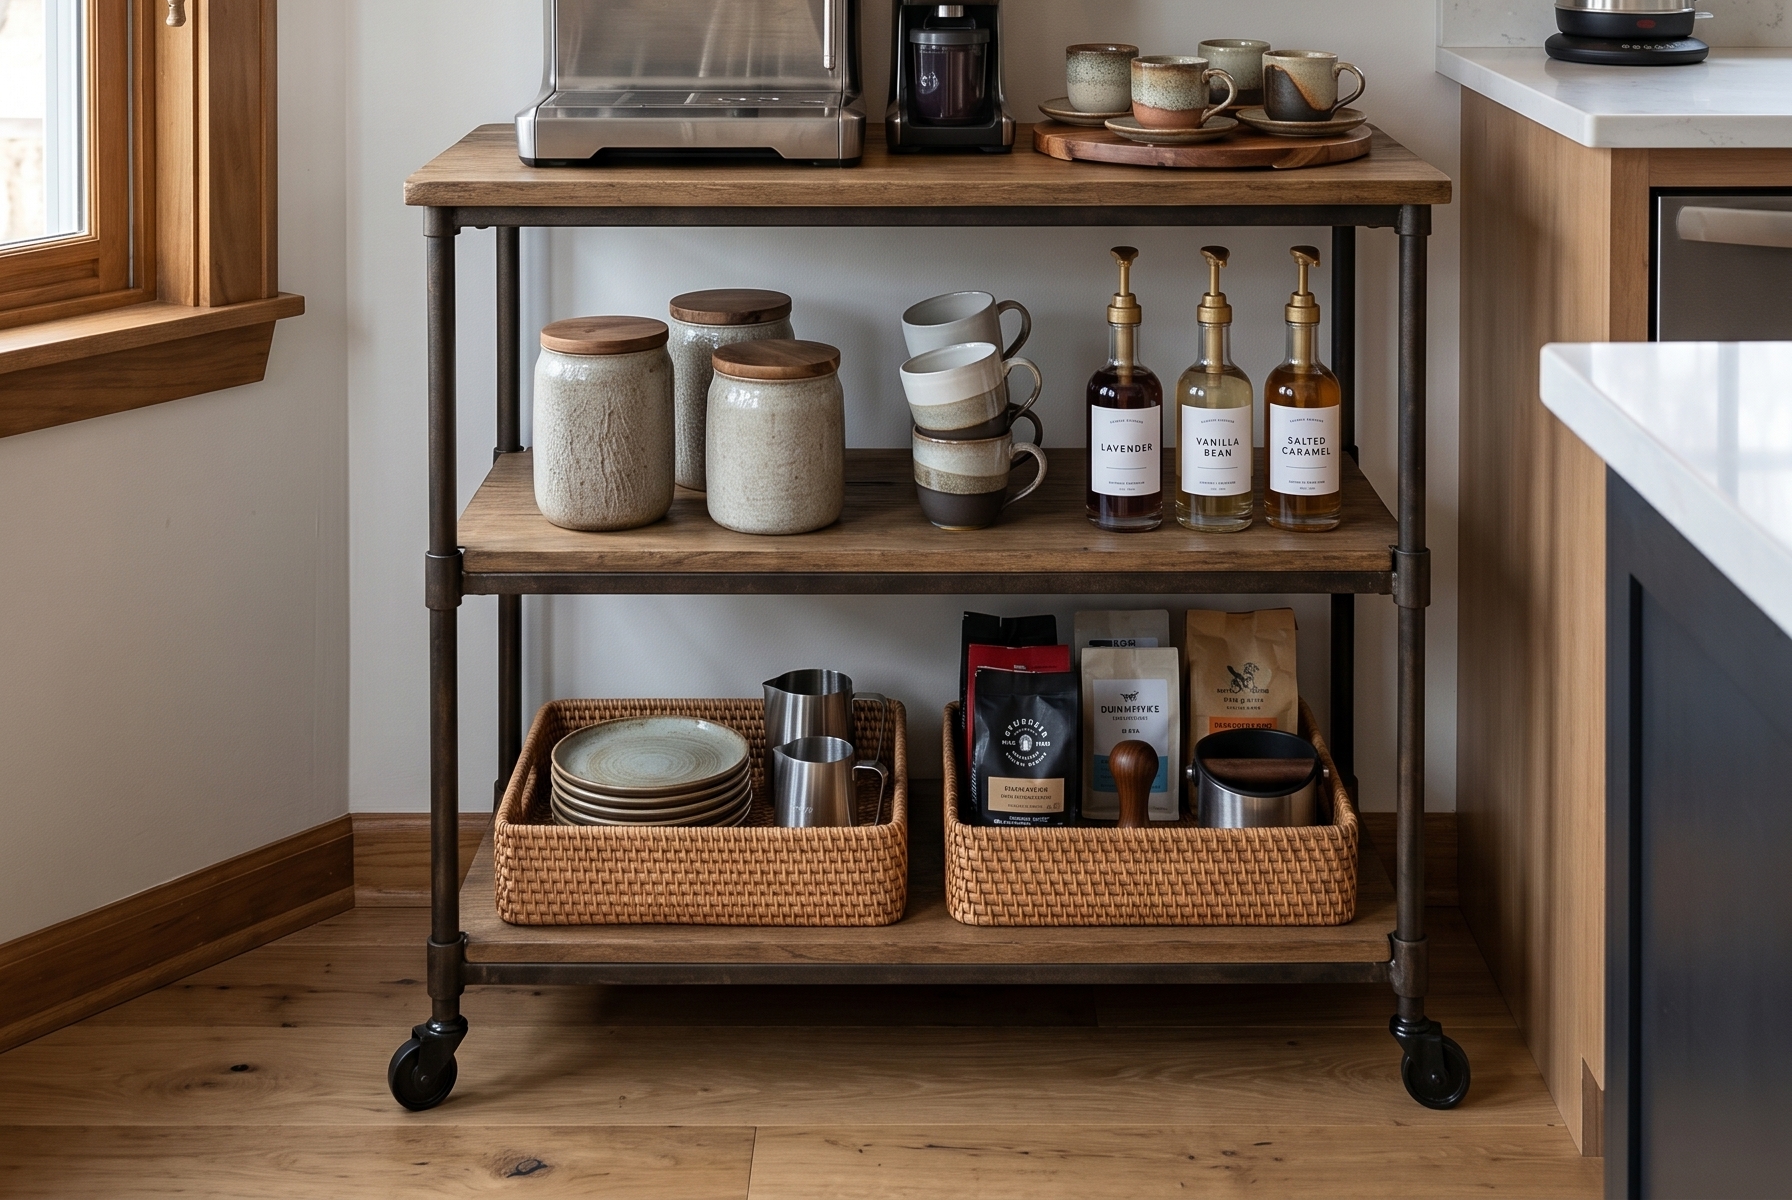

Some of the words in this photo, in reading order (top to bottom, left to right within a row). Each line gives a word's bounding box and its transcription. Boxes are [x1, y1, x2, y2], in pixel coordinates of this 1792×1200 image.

[1196, 437, 1239, 447] VANILLA
[1287, 436, 1326, 446] SALTED
[1101, 443, 1153, 453] LAVENDER
[1204, 448, 1232, 457] BEAN
[1281, 446, 1331, 456] CARAMEL
